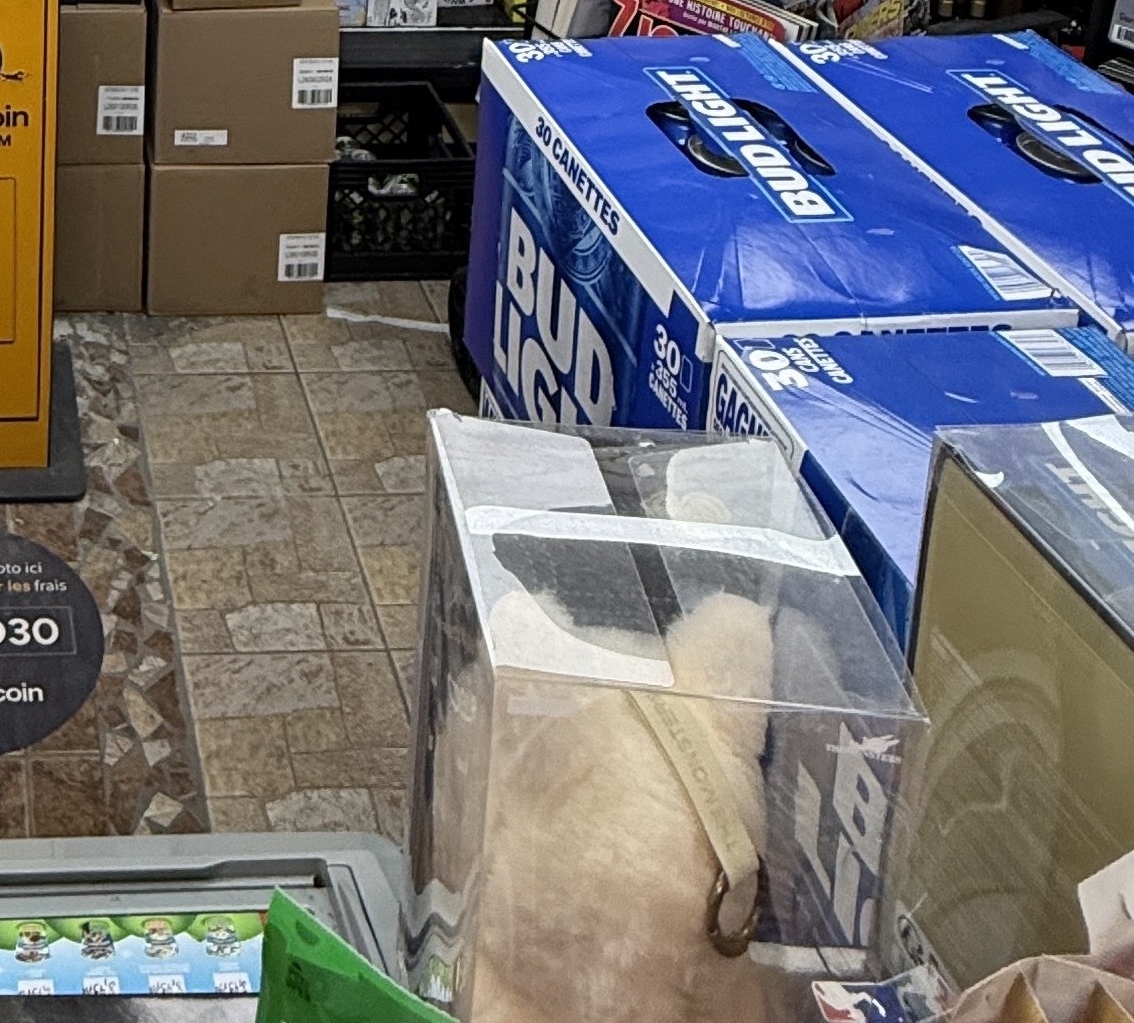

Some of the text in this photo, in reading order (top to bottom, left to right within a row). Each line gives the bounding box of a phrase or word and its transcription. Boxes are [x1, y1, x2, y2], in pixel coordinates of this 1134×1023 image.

[961, 71, 1103, 147] LIGHT
[654, 69, 836, 218] BUD LIGHT
[535, 116, 621, 236] 30 CANETTES
[506, 206, 614, 427] BUD
[653, 323, 681, 377] 30
[749, 349, 808, 392] 30
[792, 337, 854, 385] CANETTES
[649, 371, 688, 431] CANETTES
[7, 579, 31, 592] les
[34, 579, 68, 592] frais
[24, 561, 43, 574] ici
